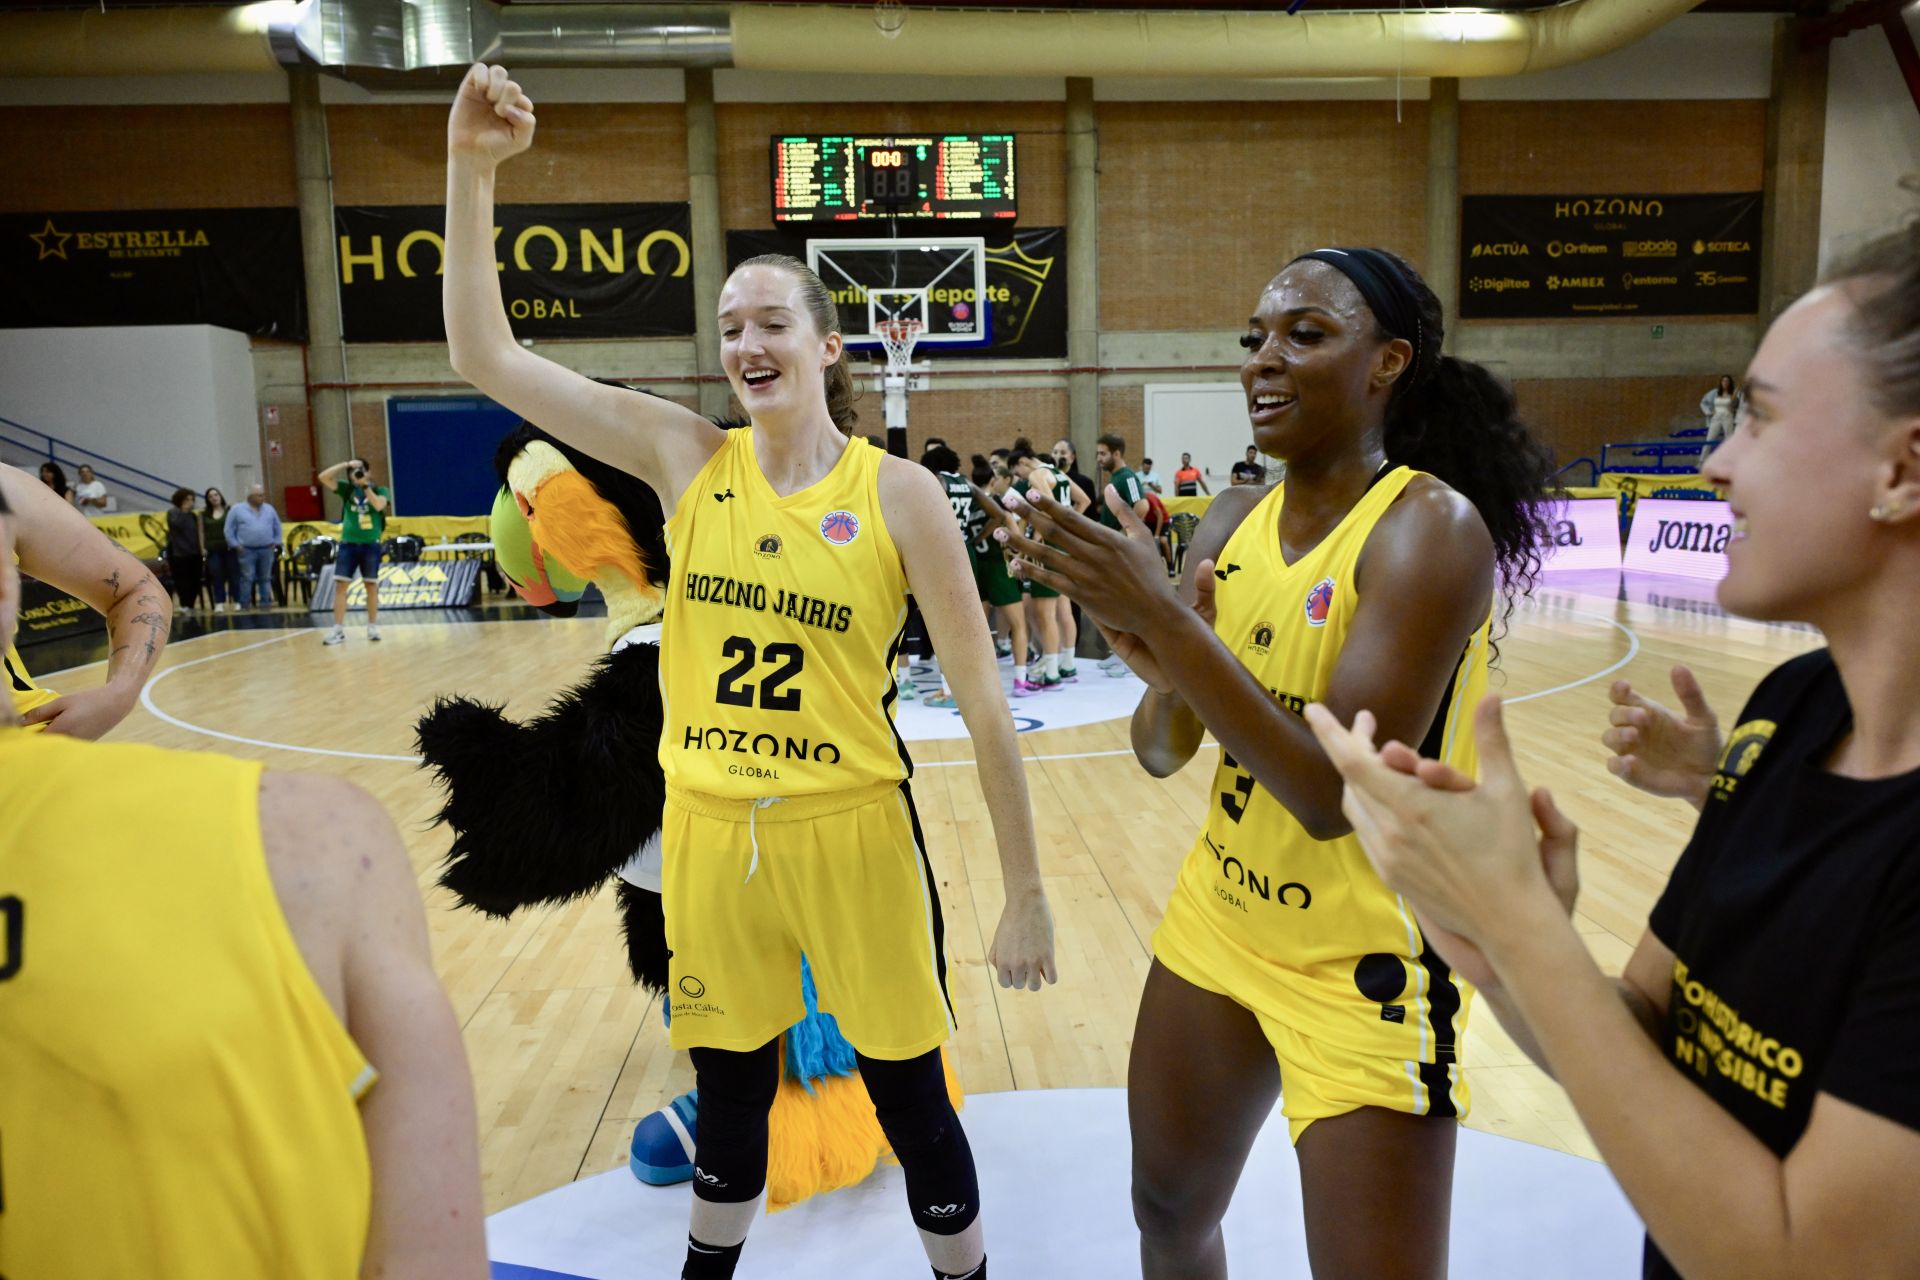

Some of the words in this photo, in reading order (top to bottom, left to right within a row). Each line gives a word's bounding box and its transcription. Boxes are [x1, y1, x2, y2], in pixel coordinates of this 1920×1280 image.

[1555, 199, 1662, 218] HOZONO
[76, 230, 210, 249] ESTRELLA
[1483, 241, 1529, 255] ACTÚA
[1564, 243, 1608, 254] Orthem
[508, 299, 582, 319] OBAL
[686, 573, 766, 612] HOZONO
[773, 588, 853, 634] JAIRIS
[716, 635, 804, 711] 22
[684, 726, 841, 764] HOZONO
[728, 765, 780, 780] GLOBAL
[671, 1003, 692, 1011] osta
